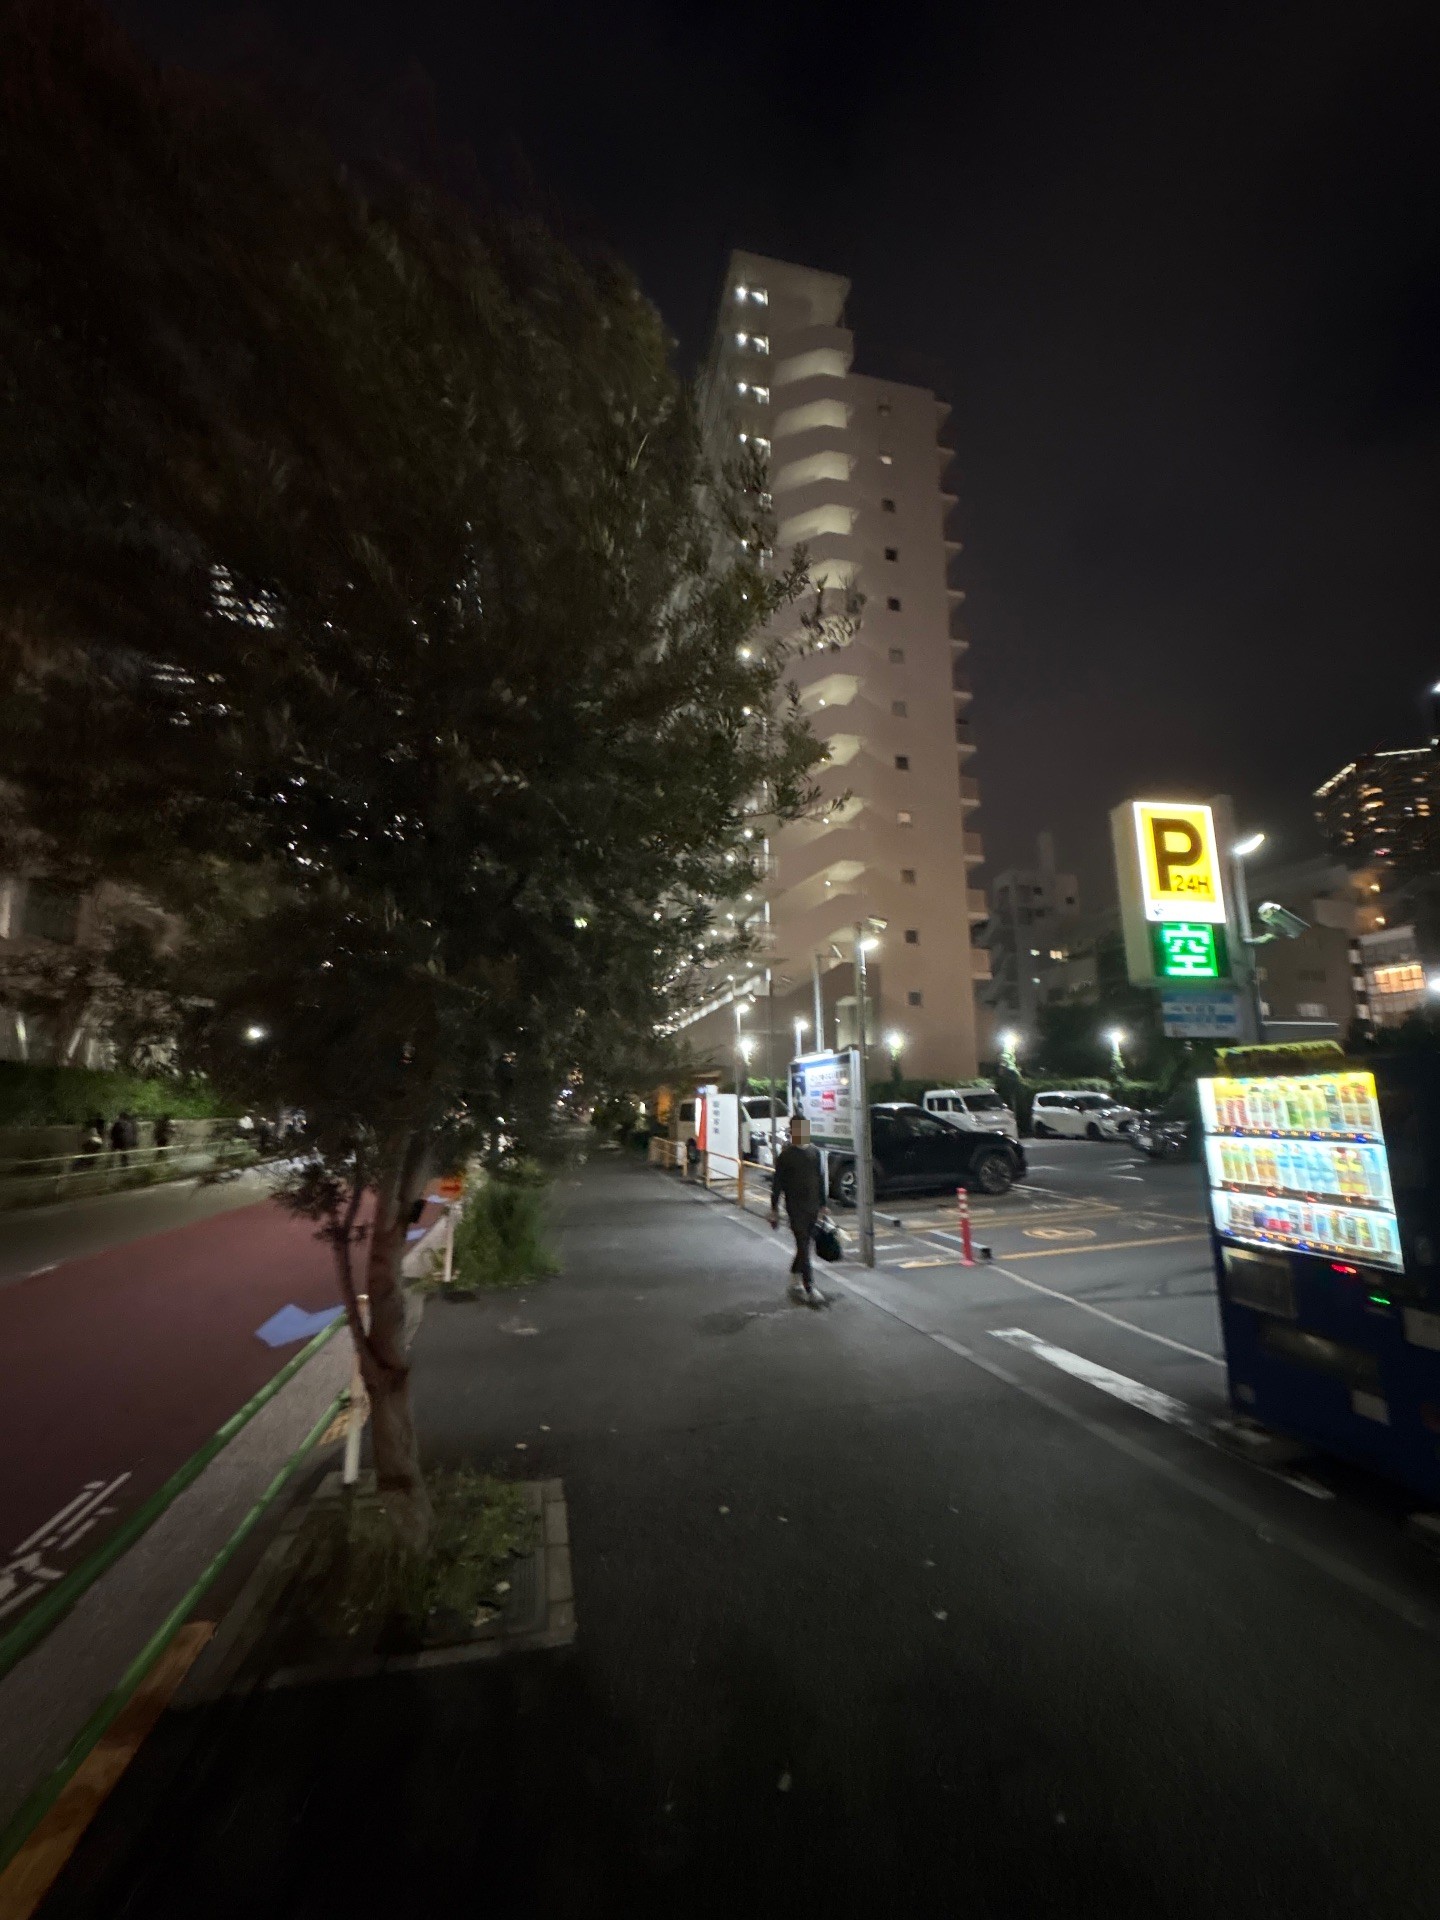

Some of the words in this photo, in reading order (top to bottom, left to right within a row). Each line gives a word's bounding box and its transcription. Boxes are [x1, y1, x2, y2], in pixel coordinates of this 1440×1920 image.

[1151, 817, 1203, 892] P
[1174, 874, 1210, 894] 24H
[1161, 923, 1216, 977] 空
